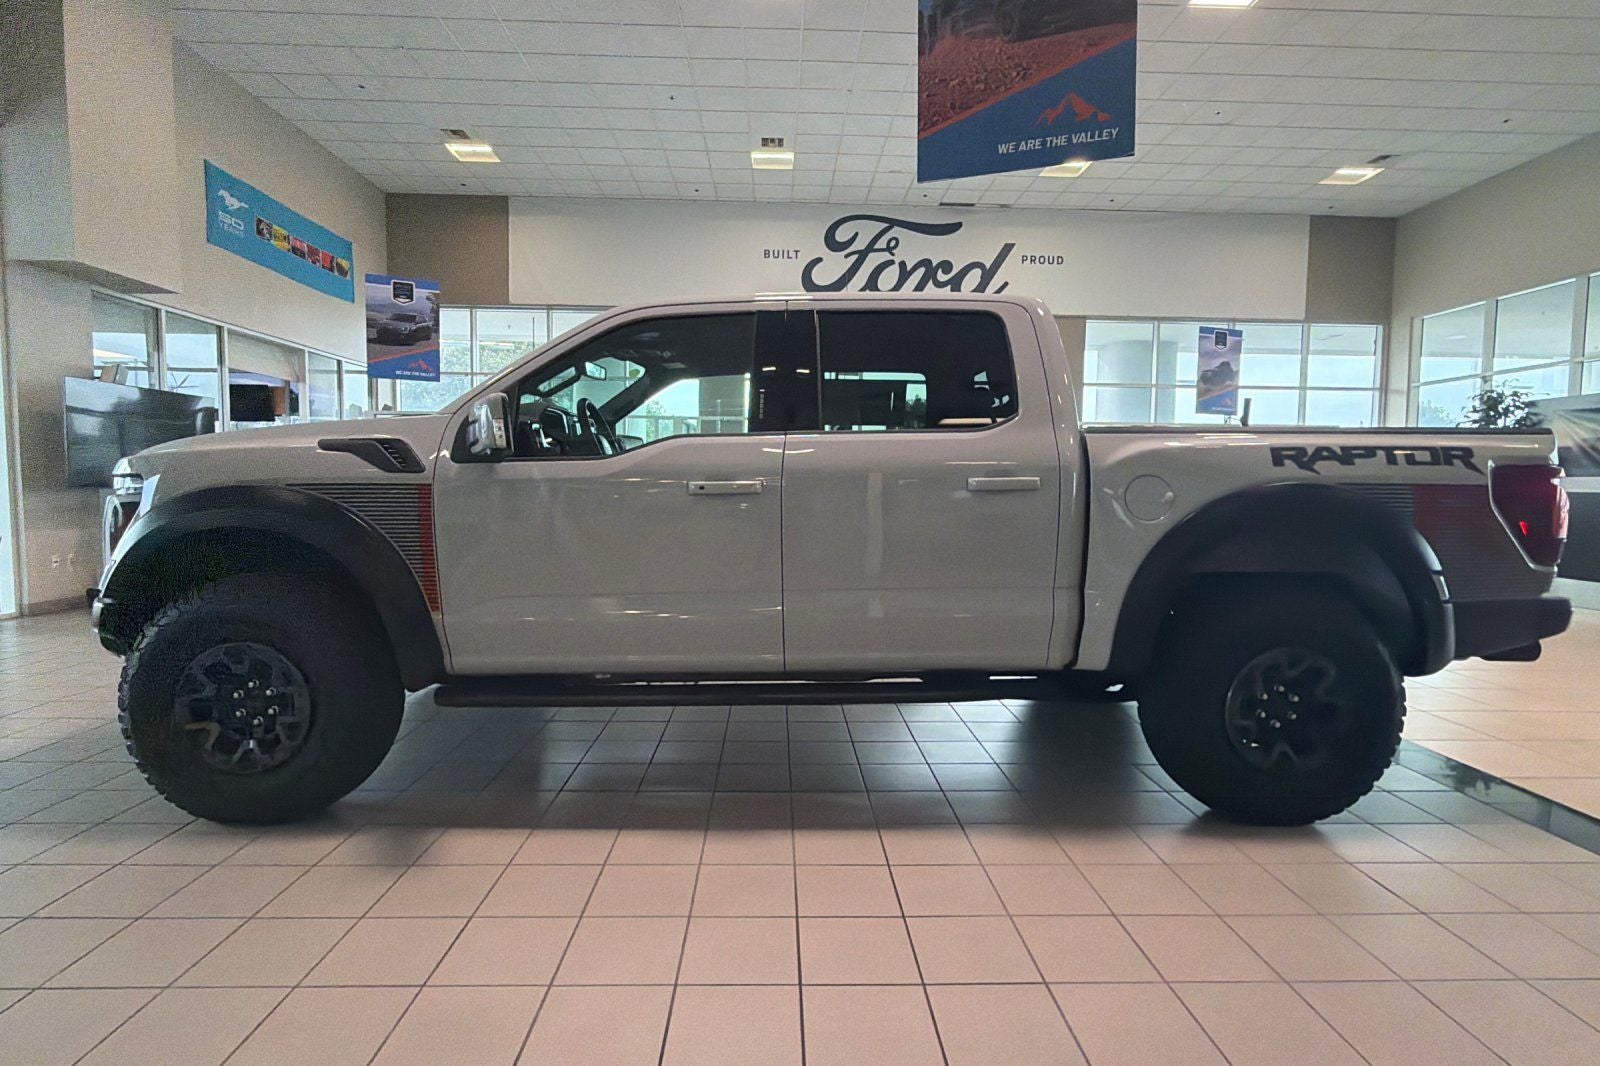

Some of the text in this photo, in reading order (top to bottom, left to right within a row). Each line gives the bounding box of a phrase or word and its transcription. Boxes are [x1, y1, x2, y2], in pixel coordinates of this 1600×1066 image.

[998, 127, 1119, 154] WE ARE THE VALLEY
[763, 214, 1065, 294] BUILT Ford PROUD
[1269, 446, 1485, 475] RAPTOR
